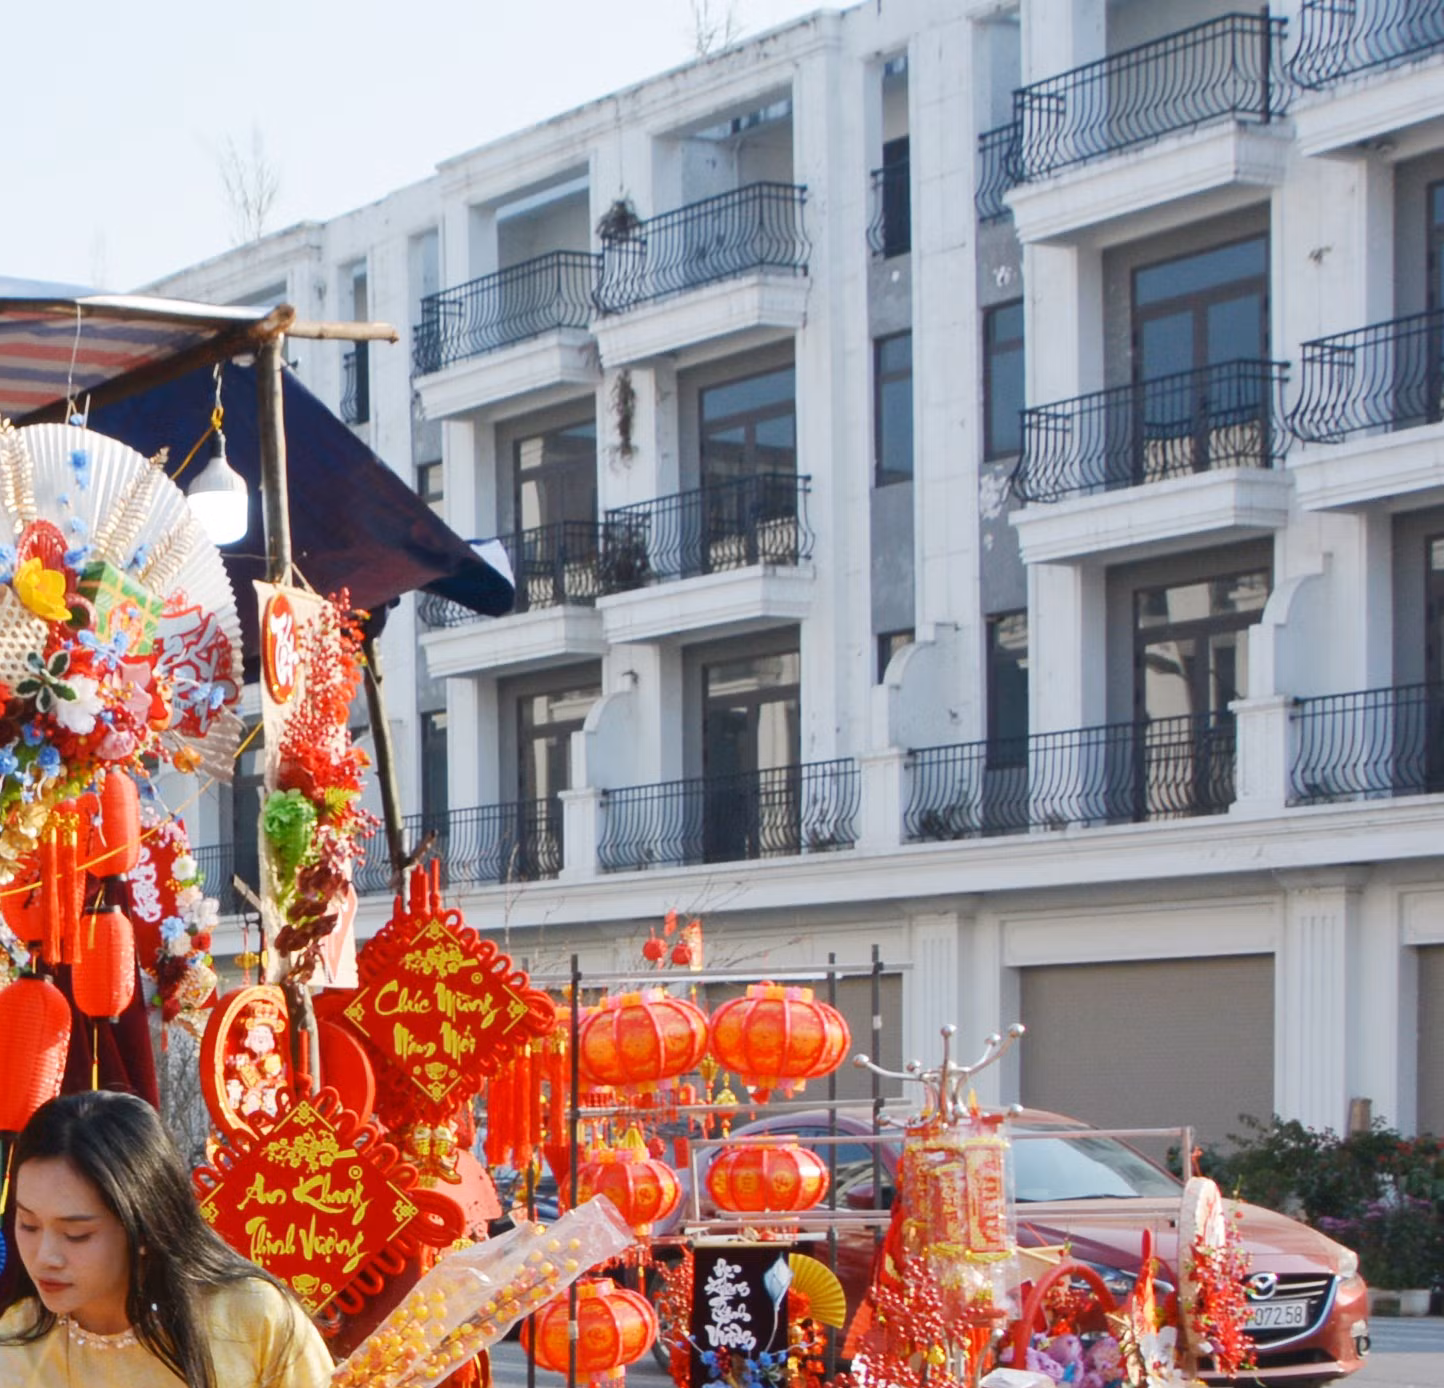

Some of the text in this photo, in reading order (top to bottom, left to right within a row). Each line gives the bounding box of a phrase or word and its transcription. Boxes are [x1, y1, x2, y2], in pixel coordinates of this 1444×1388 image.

[374, 978, 503, 1030] Chúc Mừng
[393, 1021, 476, 1066] Năm Mới
[236, 1172, 374, 1226] An Khang
[244, 1212, 370, 1275] Thịnh Vượng
